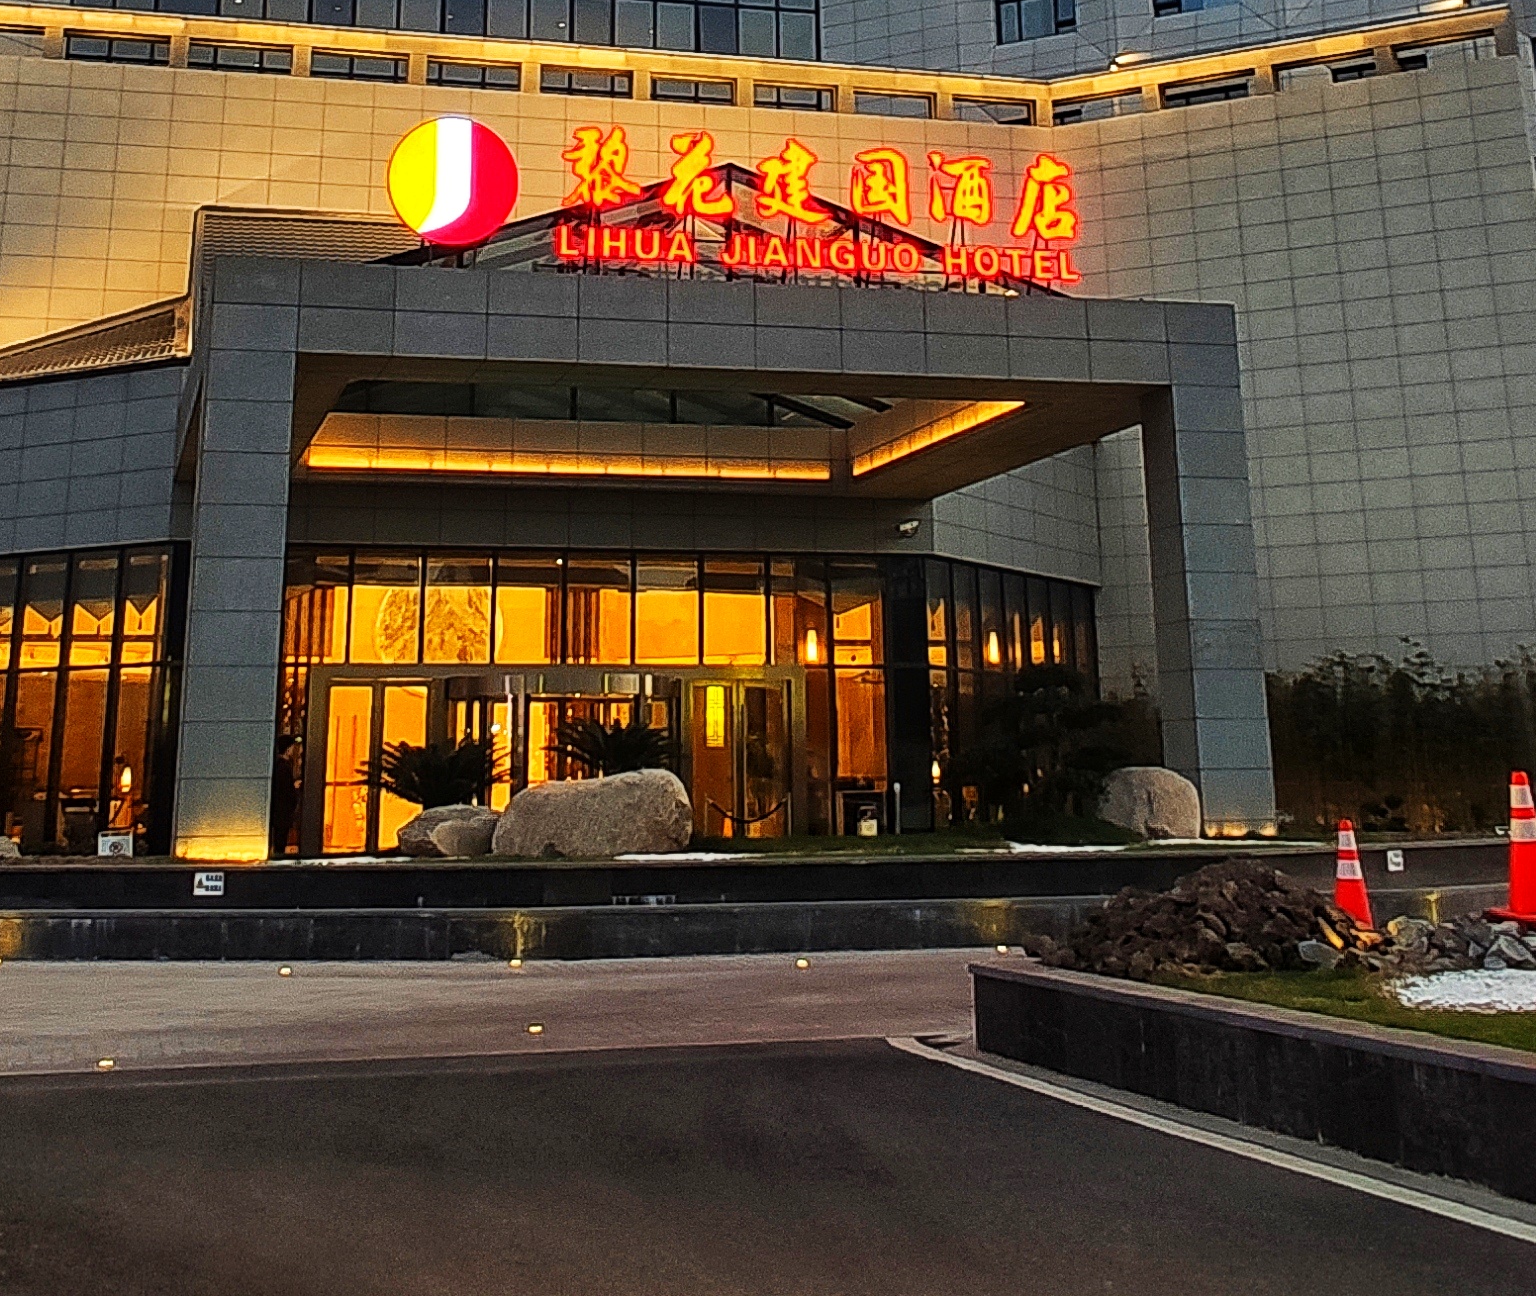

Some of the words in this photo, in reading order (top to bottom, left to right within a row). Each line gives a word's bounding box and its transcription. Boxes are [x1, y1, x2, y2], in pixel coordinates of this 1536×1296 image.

[559, 225, 695, 262] LIHUA
[721, 234, 920, 271] JIANGUO
[945, 245, 1081, 281] HOTEL
